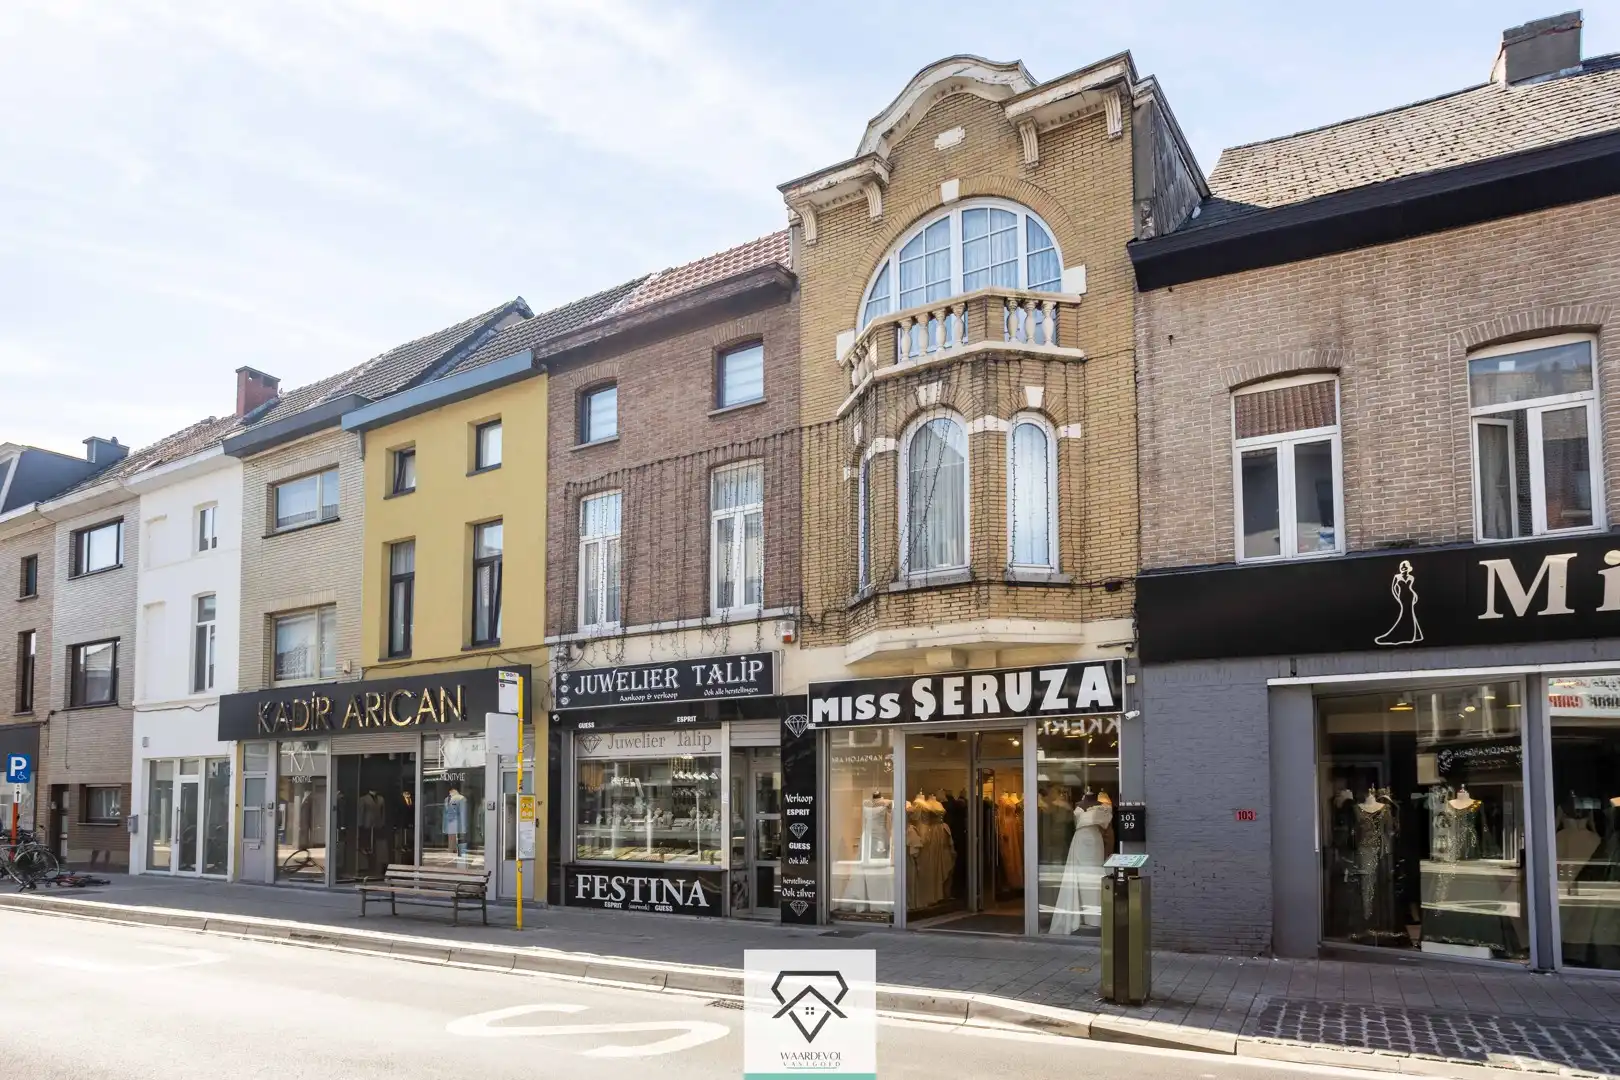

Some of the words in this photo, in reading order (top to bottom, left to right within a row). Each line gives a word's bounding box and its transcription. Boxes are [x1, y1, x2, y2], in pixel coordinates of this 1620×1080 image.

[575, 668, 680, 695] JUWELIER
[619, 693, 646, 702] Aankoop
[653, 691, 678, 700] verkoop
[703, 688, 714, 696] Ook
[715, 687, 724, 695] alle
[724, 686, 759, 695] herstellingen
[812, 692, 901, 723] MISS
[912, 665, 1114, 721] ŞERUZA
[342, 684, 464, 728] ARICAN
[676, 715, 697, 723] ESPRIT
[578, 721, 595, 729] GUESS
[607, 731, 666, 750] Juwelier
[674, 729, 712, 751] Talip
[10, 756, 27, 777] P
[785, 792, 813, 805] Verkoop
[786, 808, 810, 816] ESPRIT
[1238, 810, 1253, 821] 103
[1120, 814, 1136, 822] 101
[1124, 822, 1135, 830] 99
[788, 842, 811, 850] GUESS
[788, 856, 799, 865] Ook
[799, 855, 809, 865] alle
[782, 876, 816, 887] herstellingen
[575, 874, 710, 907] FESTINA
[781, 887, 796, 897] Ook
[796, 887, 816, 898] zilver
[604, 901, 623, 909] ESPRIT
[654, 904, 673, 912] GUESS
